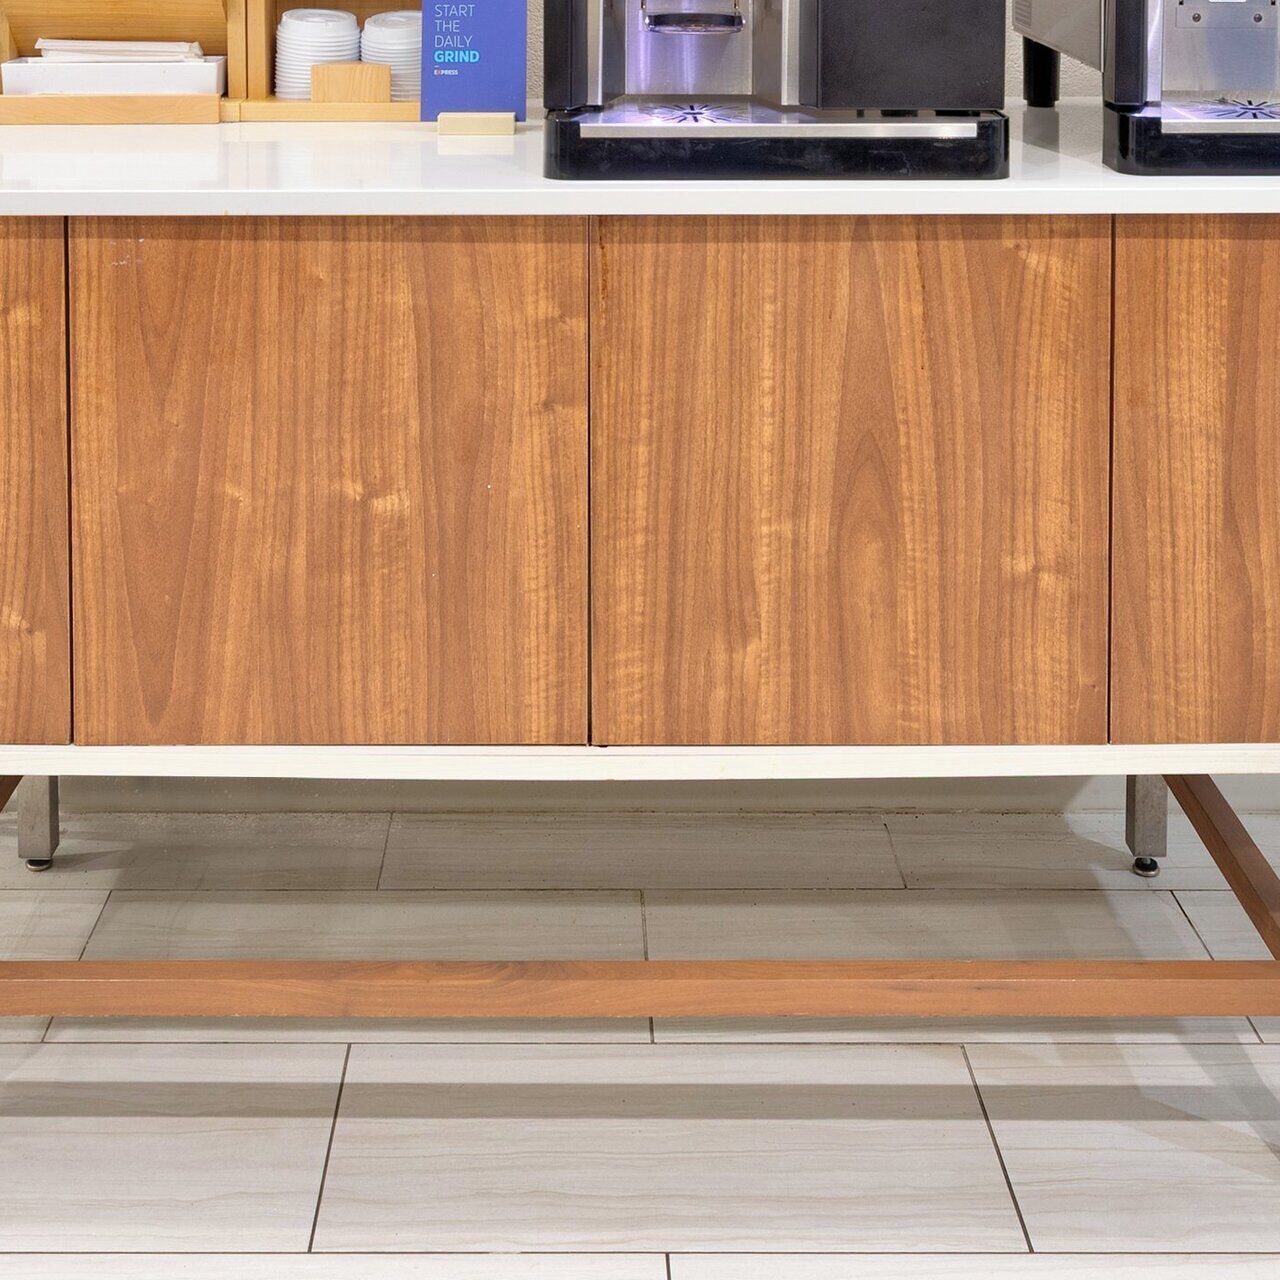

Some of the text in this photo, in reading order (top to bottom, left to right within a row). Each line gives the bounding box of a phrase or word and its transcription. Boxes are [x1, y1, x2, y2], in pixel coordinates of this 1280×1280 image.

[434, 4, 475, 18] START
[435, 19, 460, 33] THE
[434, 35, 473, 48] DAILY
[434, 50, 480, 63] GRIND
